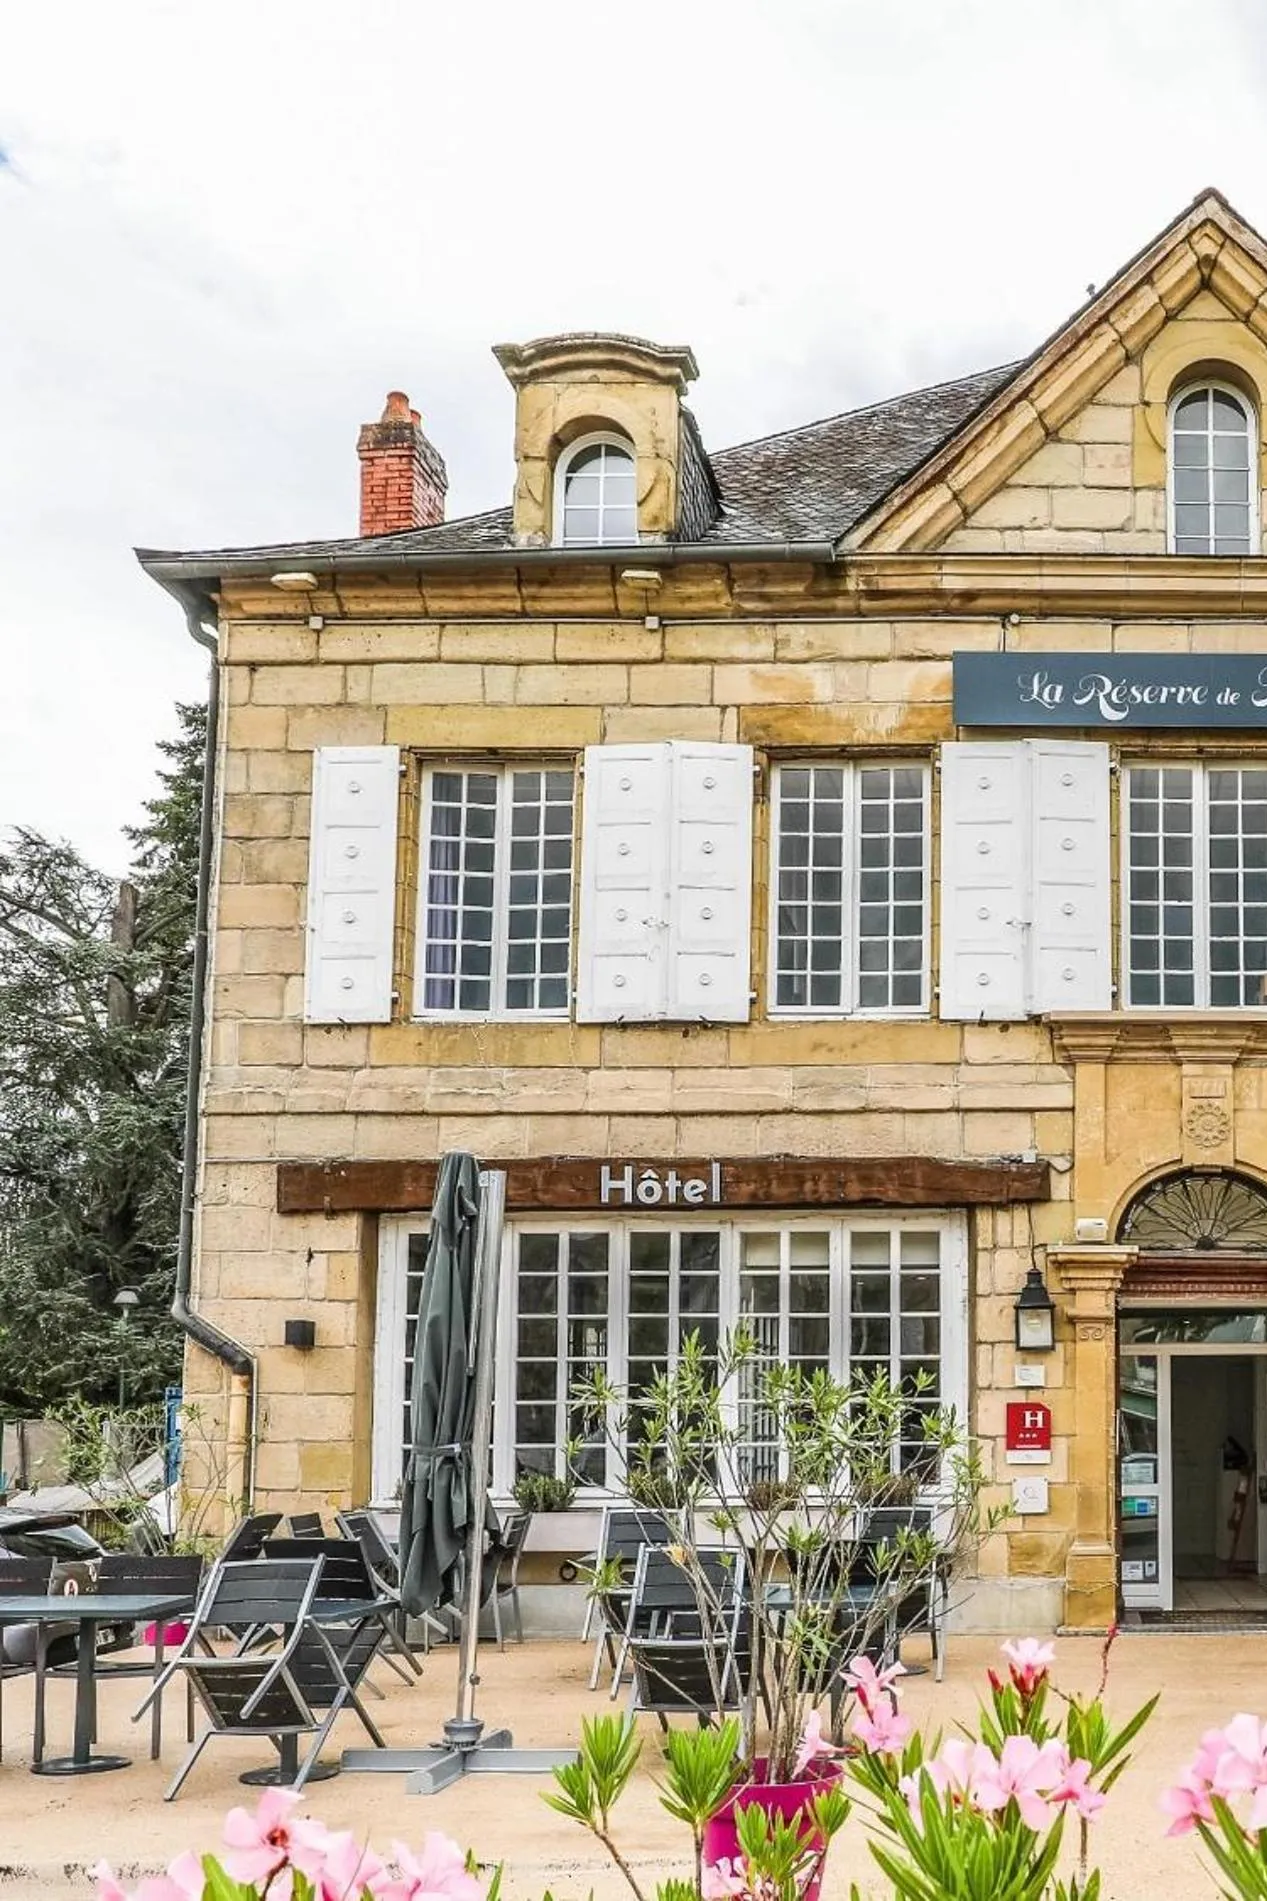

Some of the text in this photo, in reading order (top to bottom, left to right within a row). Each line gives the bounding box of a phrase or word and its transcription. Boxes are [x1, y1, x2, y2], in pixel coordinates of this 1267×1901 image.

[1018, 671, 1064, 709] La
[1073, 674, 1208, 720] Réserve
[1216, 687, 1240, 705] de
[601, 1162, 720, 1204] Hôtel
[1024, 1410, 1044, 1428] H
